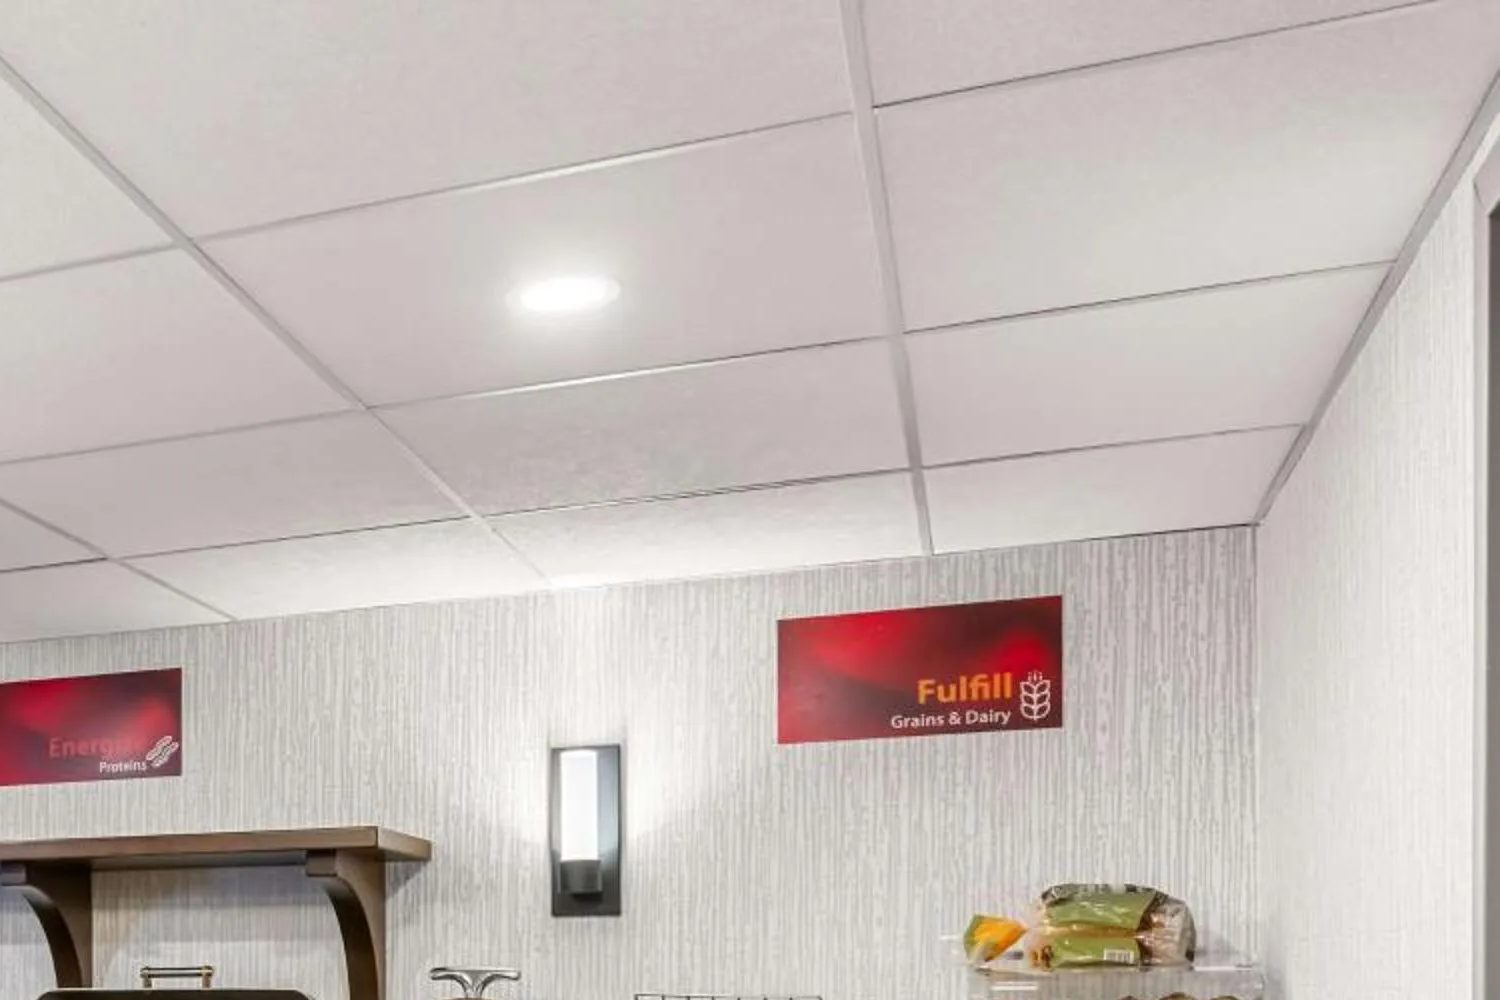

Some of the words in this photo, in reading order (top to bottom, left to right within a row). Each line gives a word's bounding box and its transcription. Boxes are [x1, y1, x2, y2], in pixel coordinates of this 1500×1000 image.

[917, 671, 1012, 704] Fulfill
[891, 712, 945, 729] Grains
[949, 712, 962, 725] &
[965, 709, 1012, 726] Dairy
[99, 758, 148, 774] Proteins
